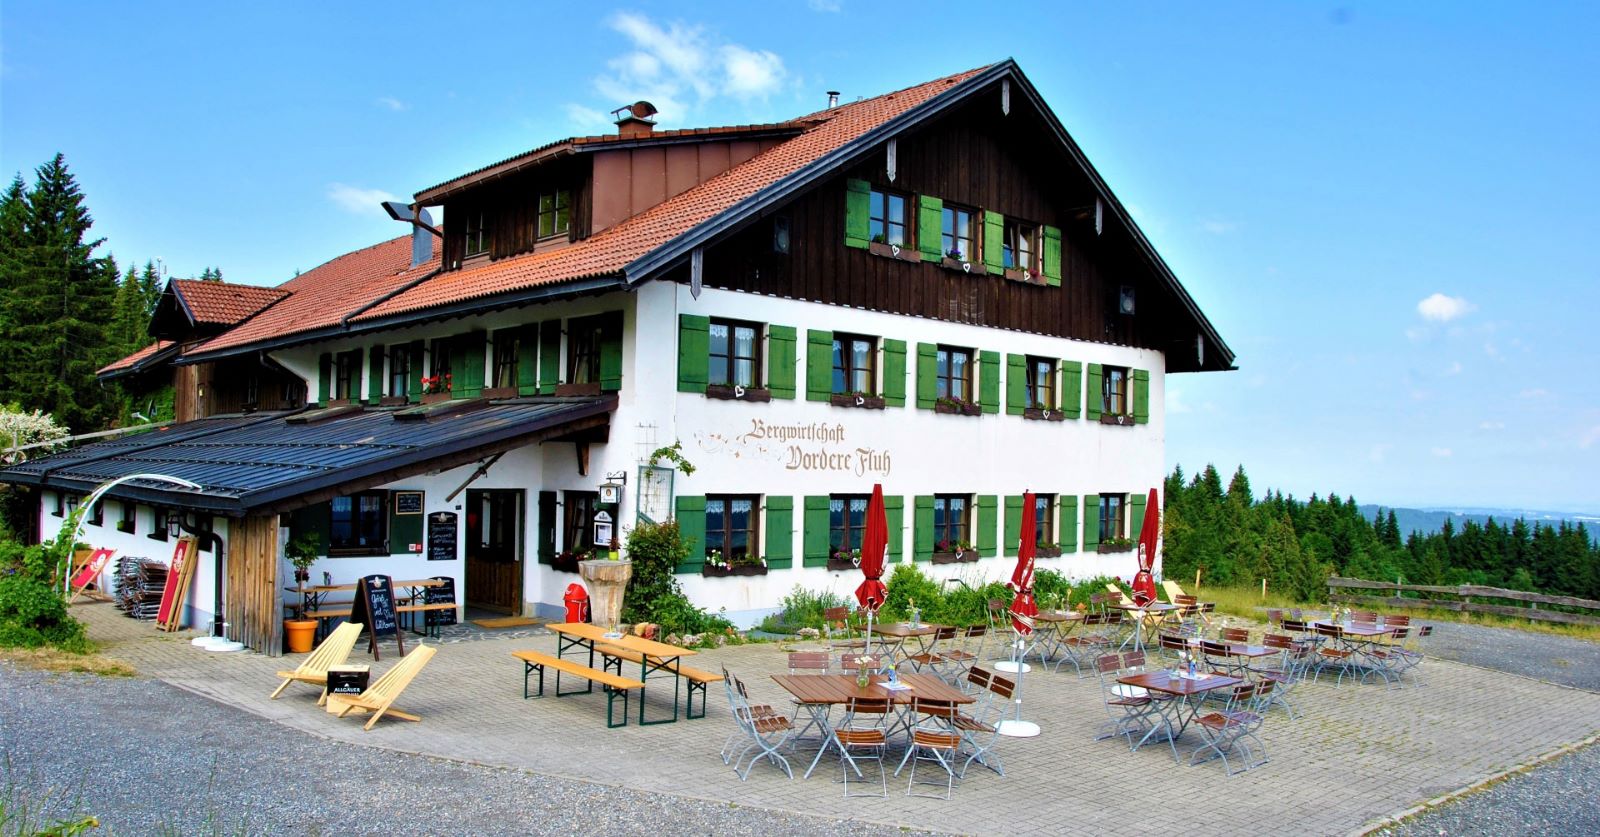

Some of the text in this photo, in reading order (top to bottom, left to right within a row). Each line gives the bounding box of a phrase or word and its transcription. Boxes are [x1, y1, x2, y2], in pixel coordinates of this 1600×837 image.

[745, 418, 845, 444] Bergwirtschaft
[786, 445, 891, 477] Vordere Fluh
